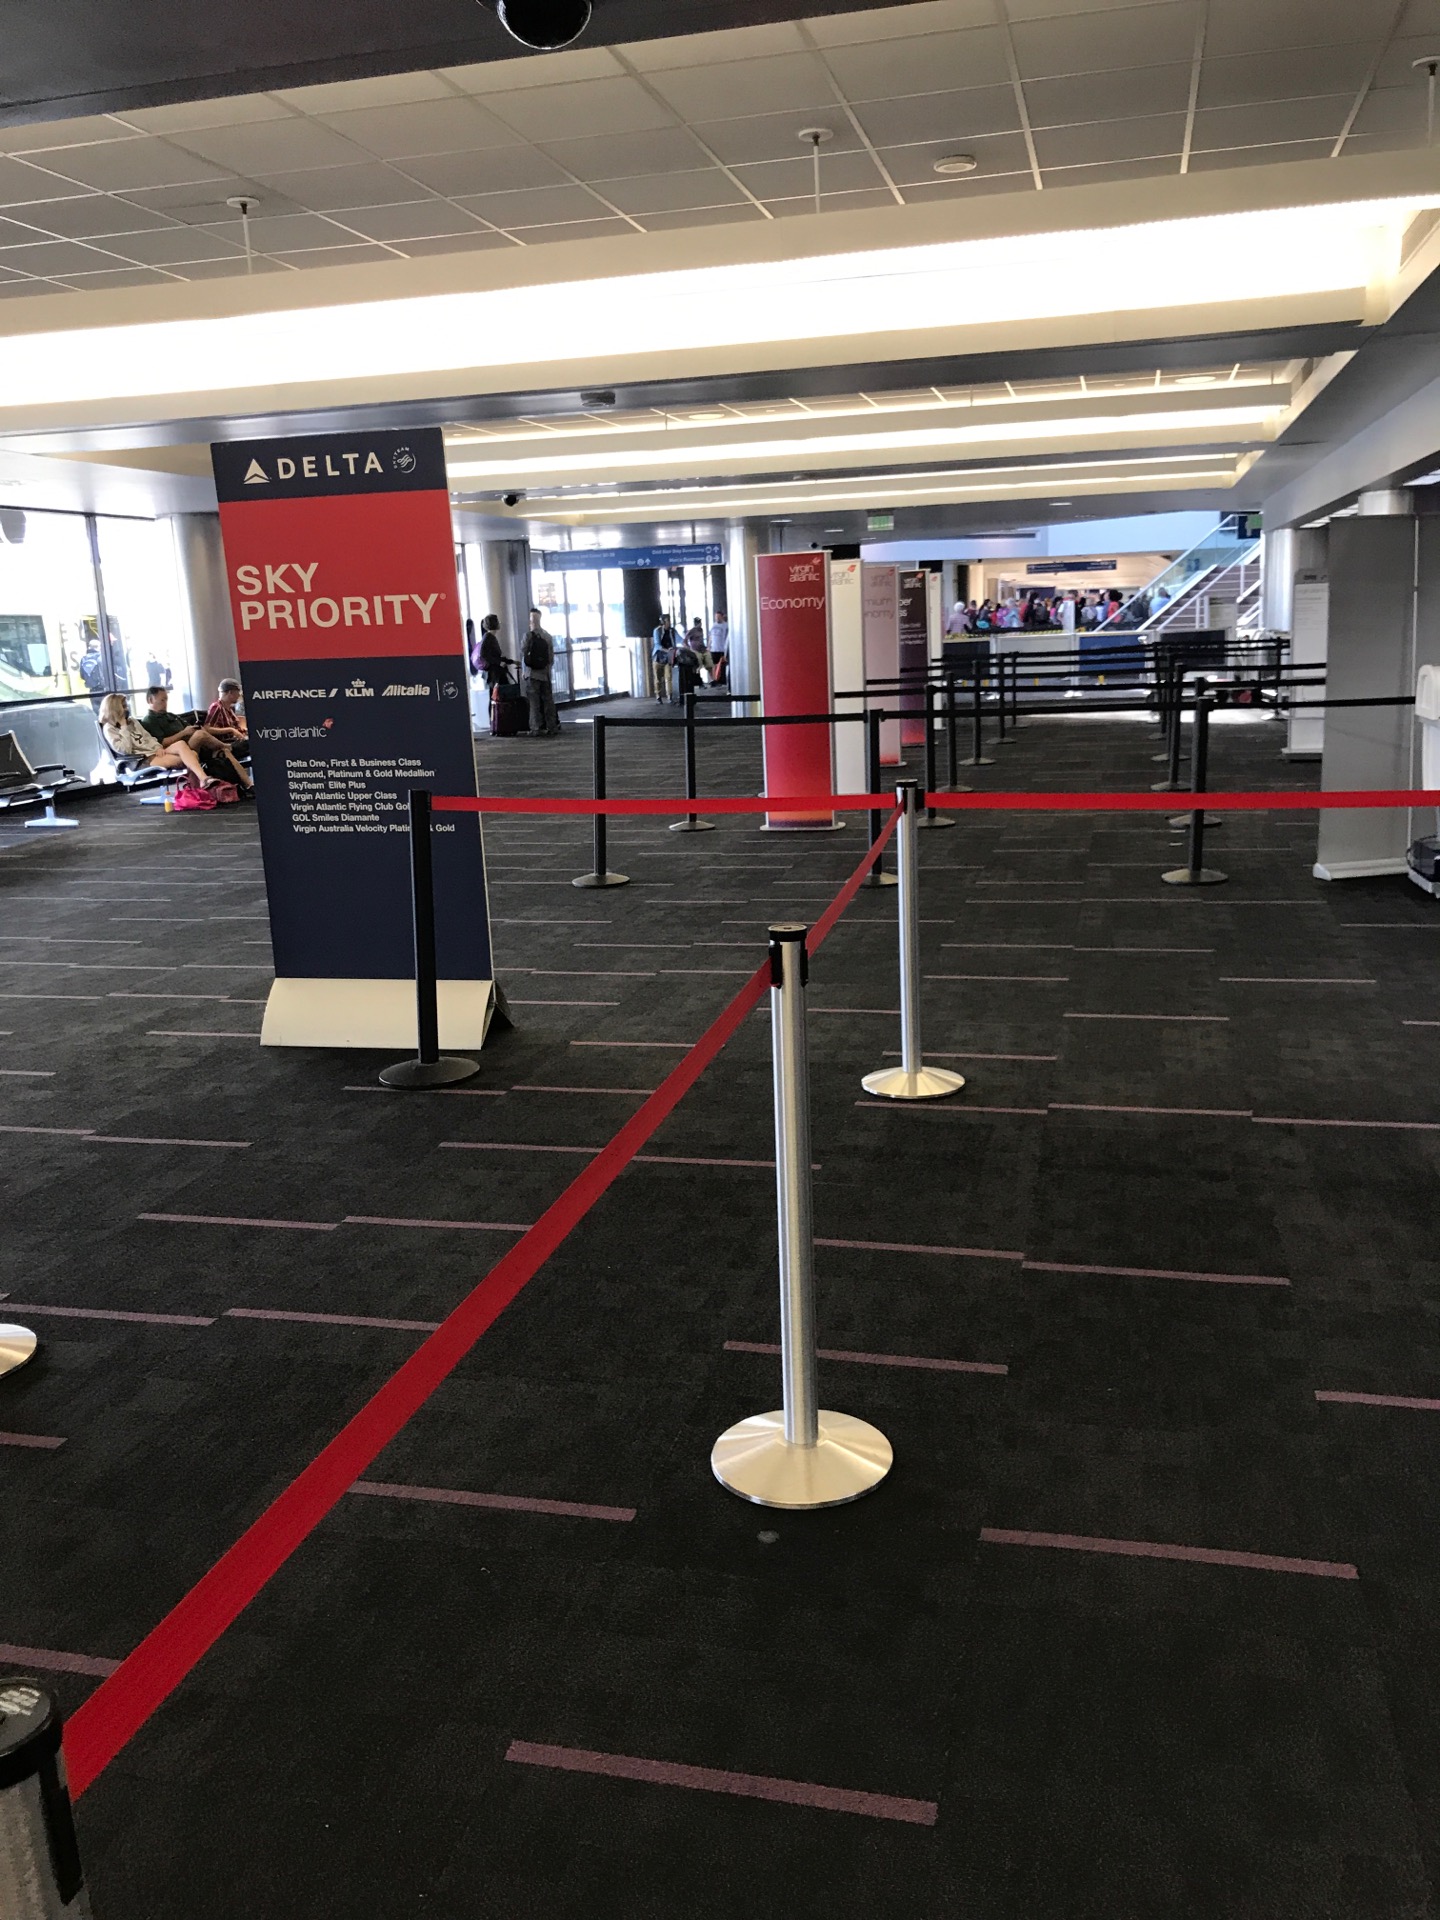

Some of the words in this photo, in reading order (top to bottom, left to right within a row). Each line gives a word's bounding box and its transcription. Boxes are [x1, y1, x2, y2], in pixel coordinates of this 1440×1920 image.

[277, 452, 384, 480] DELTA
[789, 564, 814, 575] virgin
[236, 562, 318, 596] SKY
[789, 572, 820, 582] atlantic
[760, 596, 825, 610] Economy
[252, 689, 326, 699] AIRFRANCE
[345, 688, 374, 697] KLM
[382, 684, 430, 696] Alitalia
[256, 727, 287, 740] virgin
[288, 726, 327, 738] atlantic
[286, 759, 307, 768] Delta
[309, 759, 329, 769] One,
[330, 759, 349, 768] First
[350, 759, 357, 767] &
[359, 758, 396, 767] Business
[398, 758, 421, 766] Class
[287, 770, 326, 779] Diamond,
[327, 770, 363, 778] Platinum
[373, 769, 393, 777] Gold
[395, 769, 435, 777] Medallion
[288, 781, 324, 790] SkyTeam
[328, 781, 346, 789] Elite
[348, 781, 366, 789] Plus
[289, 792, 313, 801] Virgin
[315, 792, 346, 800] Atlantic
[347, 792, 372, 801] Upper
[374, 791, 397, 799] Class
[290, 803, 314, 812] Virgin
[316, 803, 347, 811] Atlantic
[348, 803, 372, 812] Flying
[374, 802, 393, 811] Club
[395, 802, 410, 810] Gol
[292, 814, 311, 822] GOL
[312, 813, 339, 821] Smiles
[341, 813, 380, 821] Diamante
[293, 825, 316, 834] Virgin
[318, 824, 354, 832] Australia
[355, 824, 388, 833] Velocity
[435, 824, 455, 832] Gold
